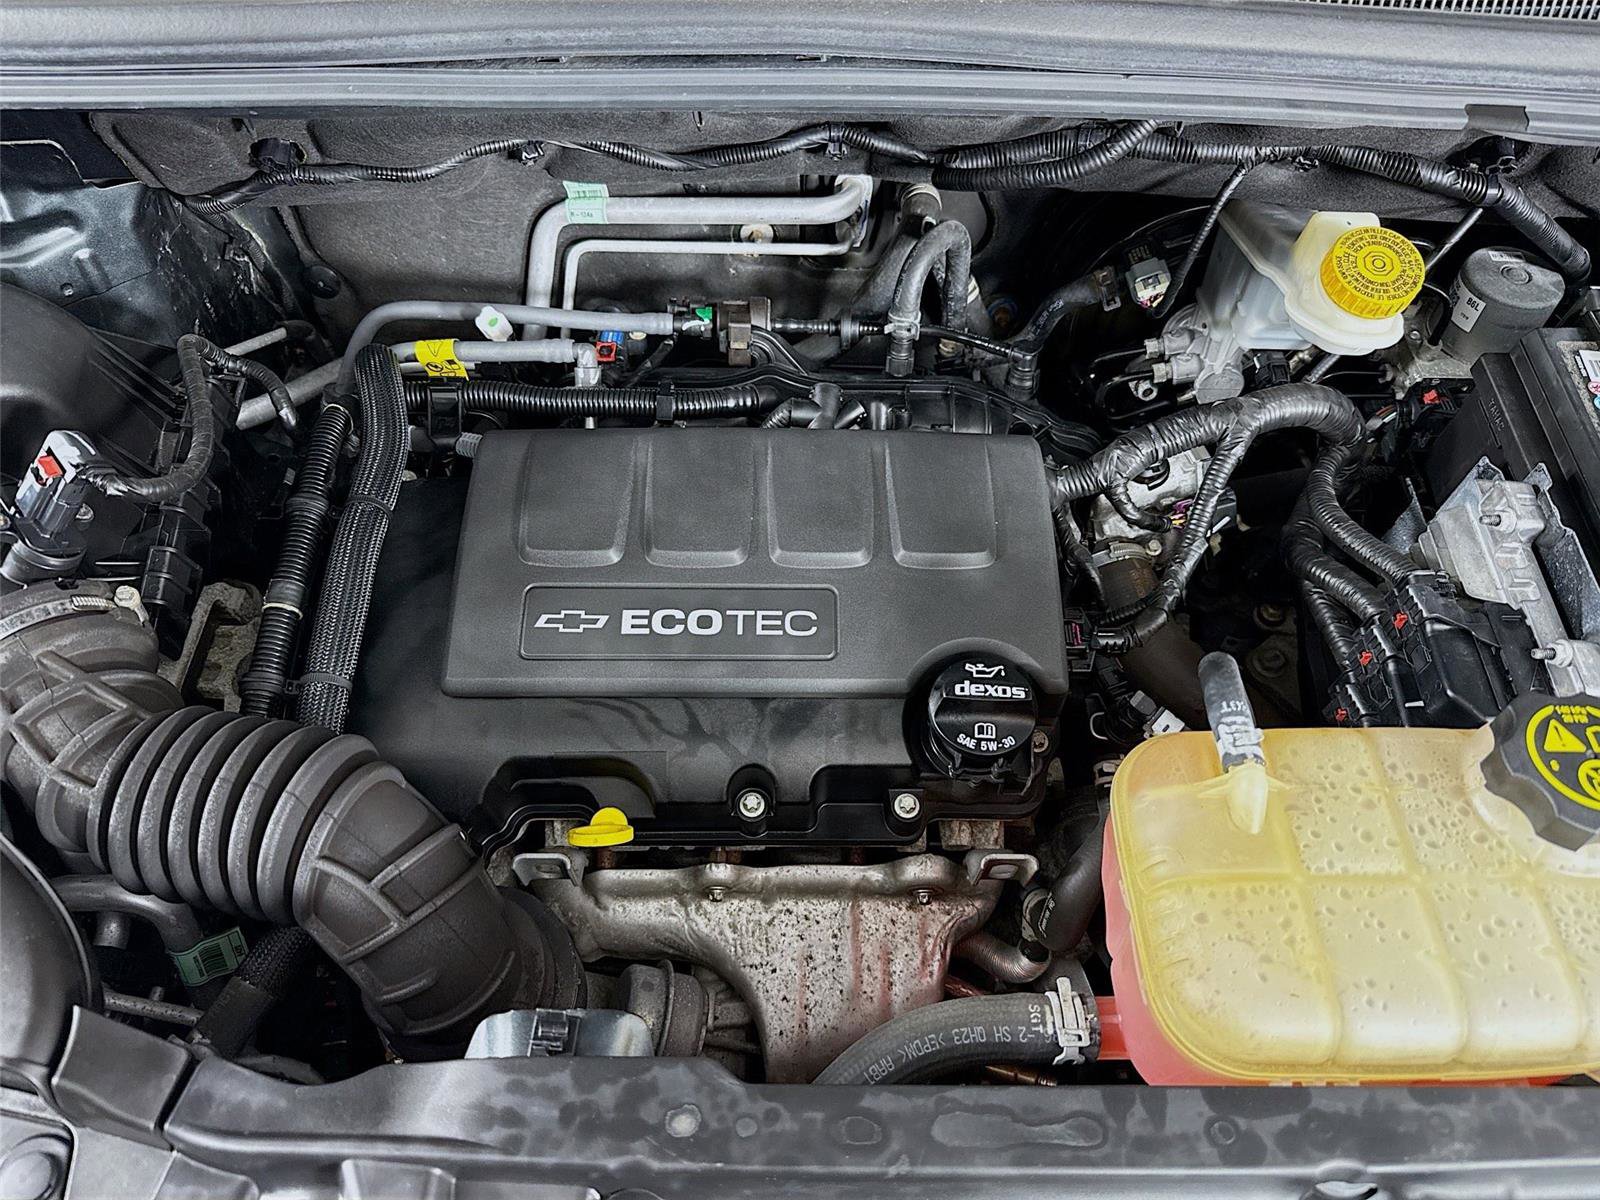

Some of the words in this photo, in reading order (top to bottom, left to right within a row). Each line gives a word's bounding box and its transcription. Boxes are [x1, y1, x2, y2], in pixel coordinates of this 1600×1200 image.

[620, 609, 818, 636] ECOTEC
[954, 681, 1027, 699] dexos
[956, 733, 976, 749] SAE
[980, 735, 1016, 751] 5W-30
[953, 1025, 987, 1045] QH23
[994, 1025, 1012, 1043] SH
